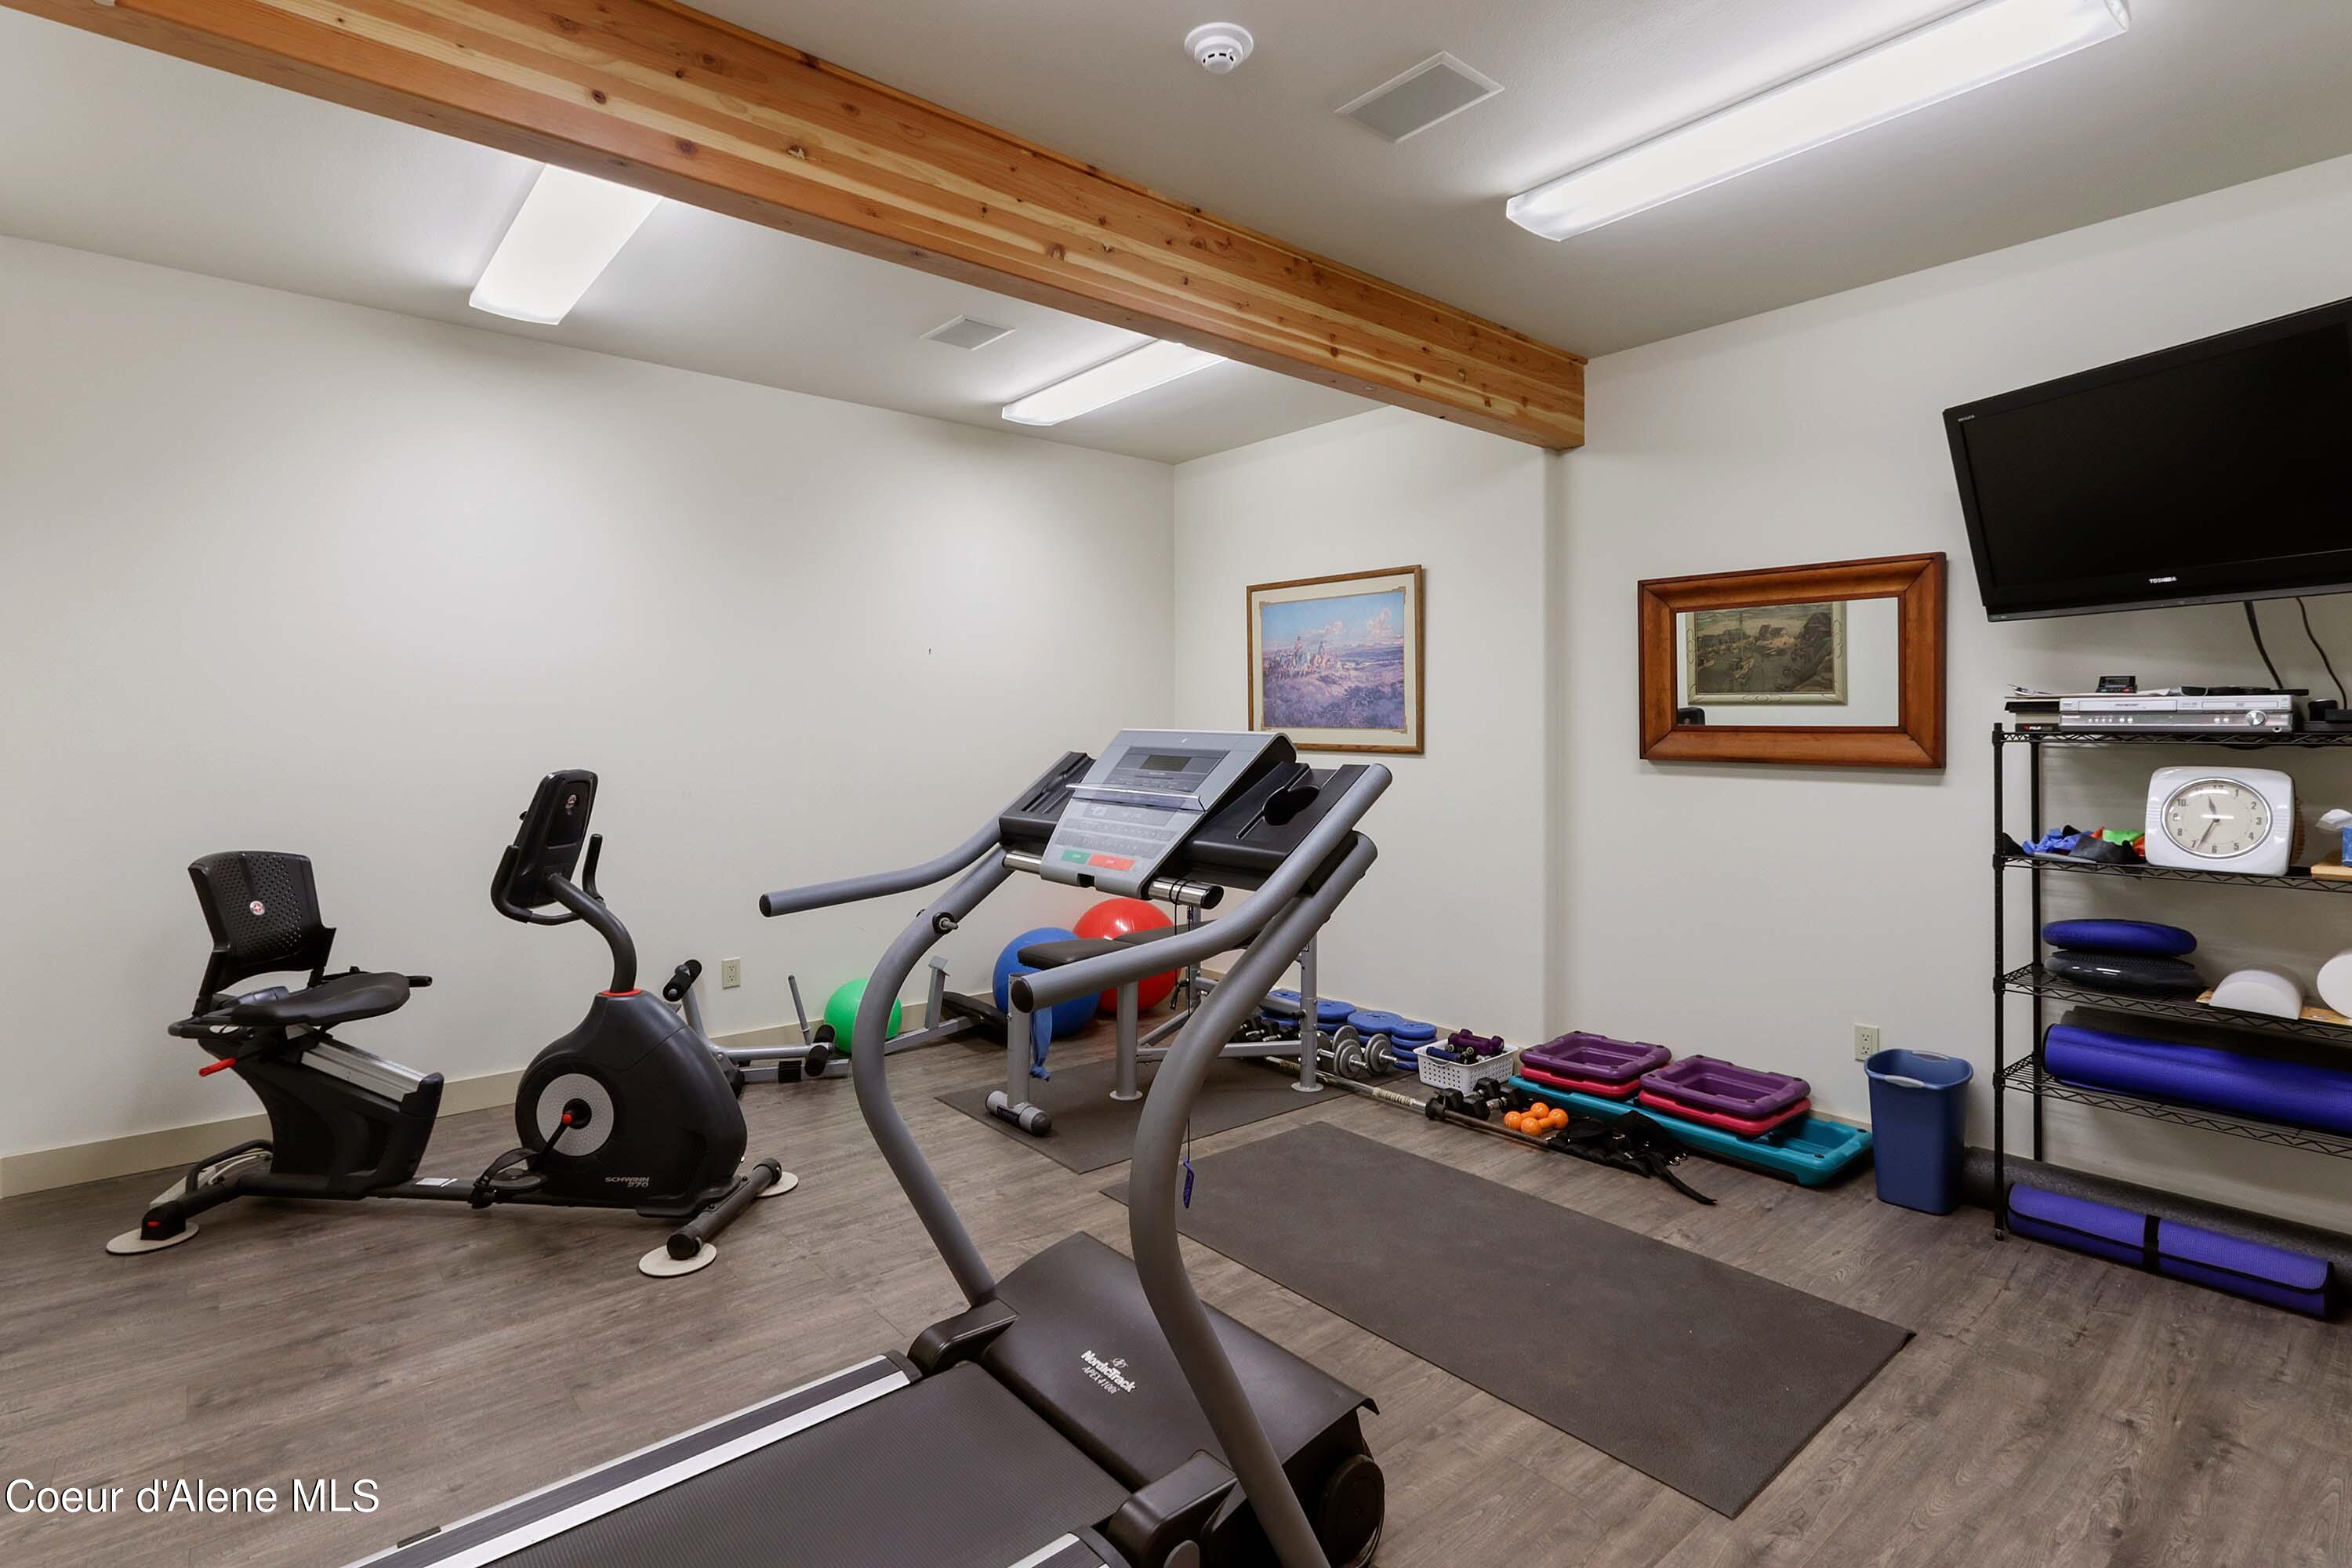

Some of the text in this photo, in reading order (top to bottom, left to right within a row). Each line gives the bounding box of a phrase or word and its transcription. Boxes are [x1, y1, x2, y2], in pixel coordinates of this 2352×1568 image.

[2177, 798, 2186, 807] 10
[2251, 801, 2257, 810] 2
[2256, 817, 2262, 826] 3
[2177, 828, 2183, 837] 8
[2249, 832, 2254, 840] 4
[2190, 840, 2197, 848] 7
[2234, 842, 2240, 851] 5
[2212, 845, 2217, 854] 6
[1080, 1349, 1136, 1392] NordicTrack
